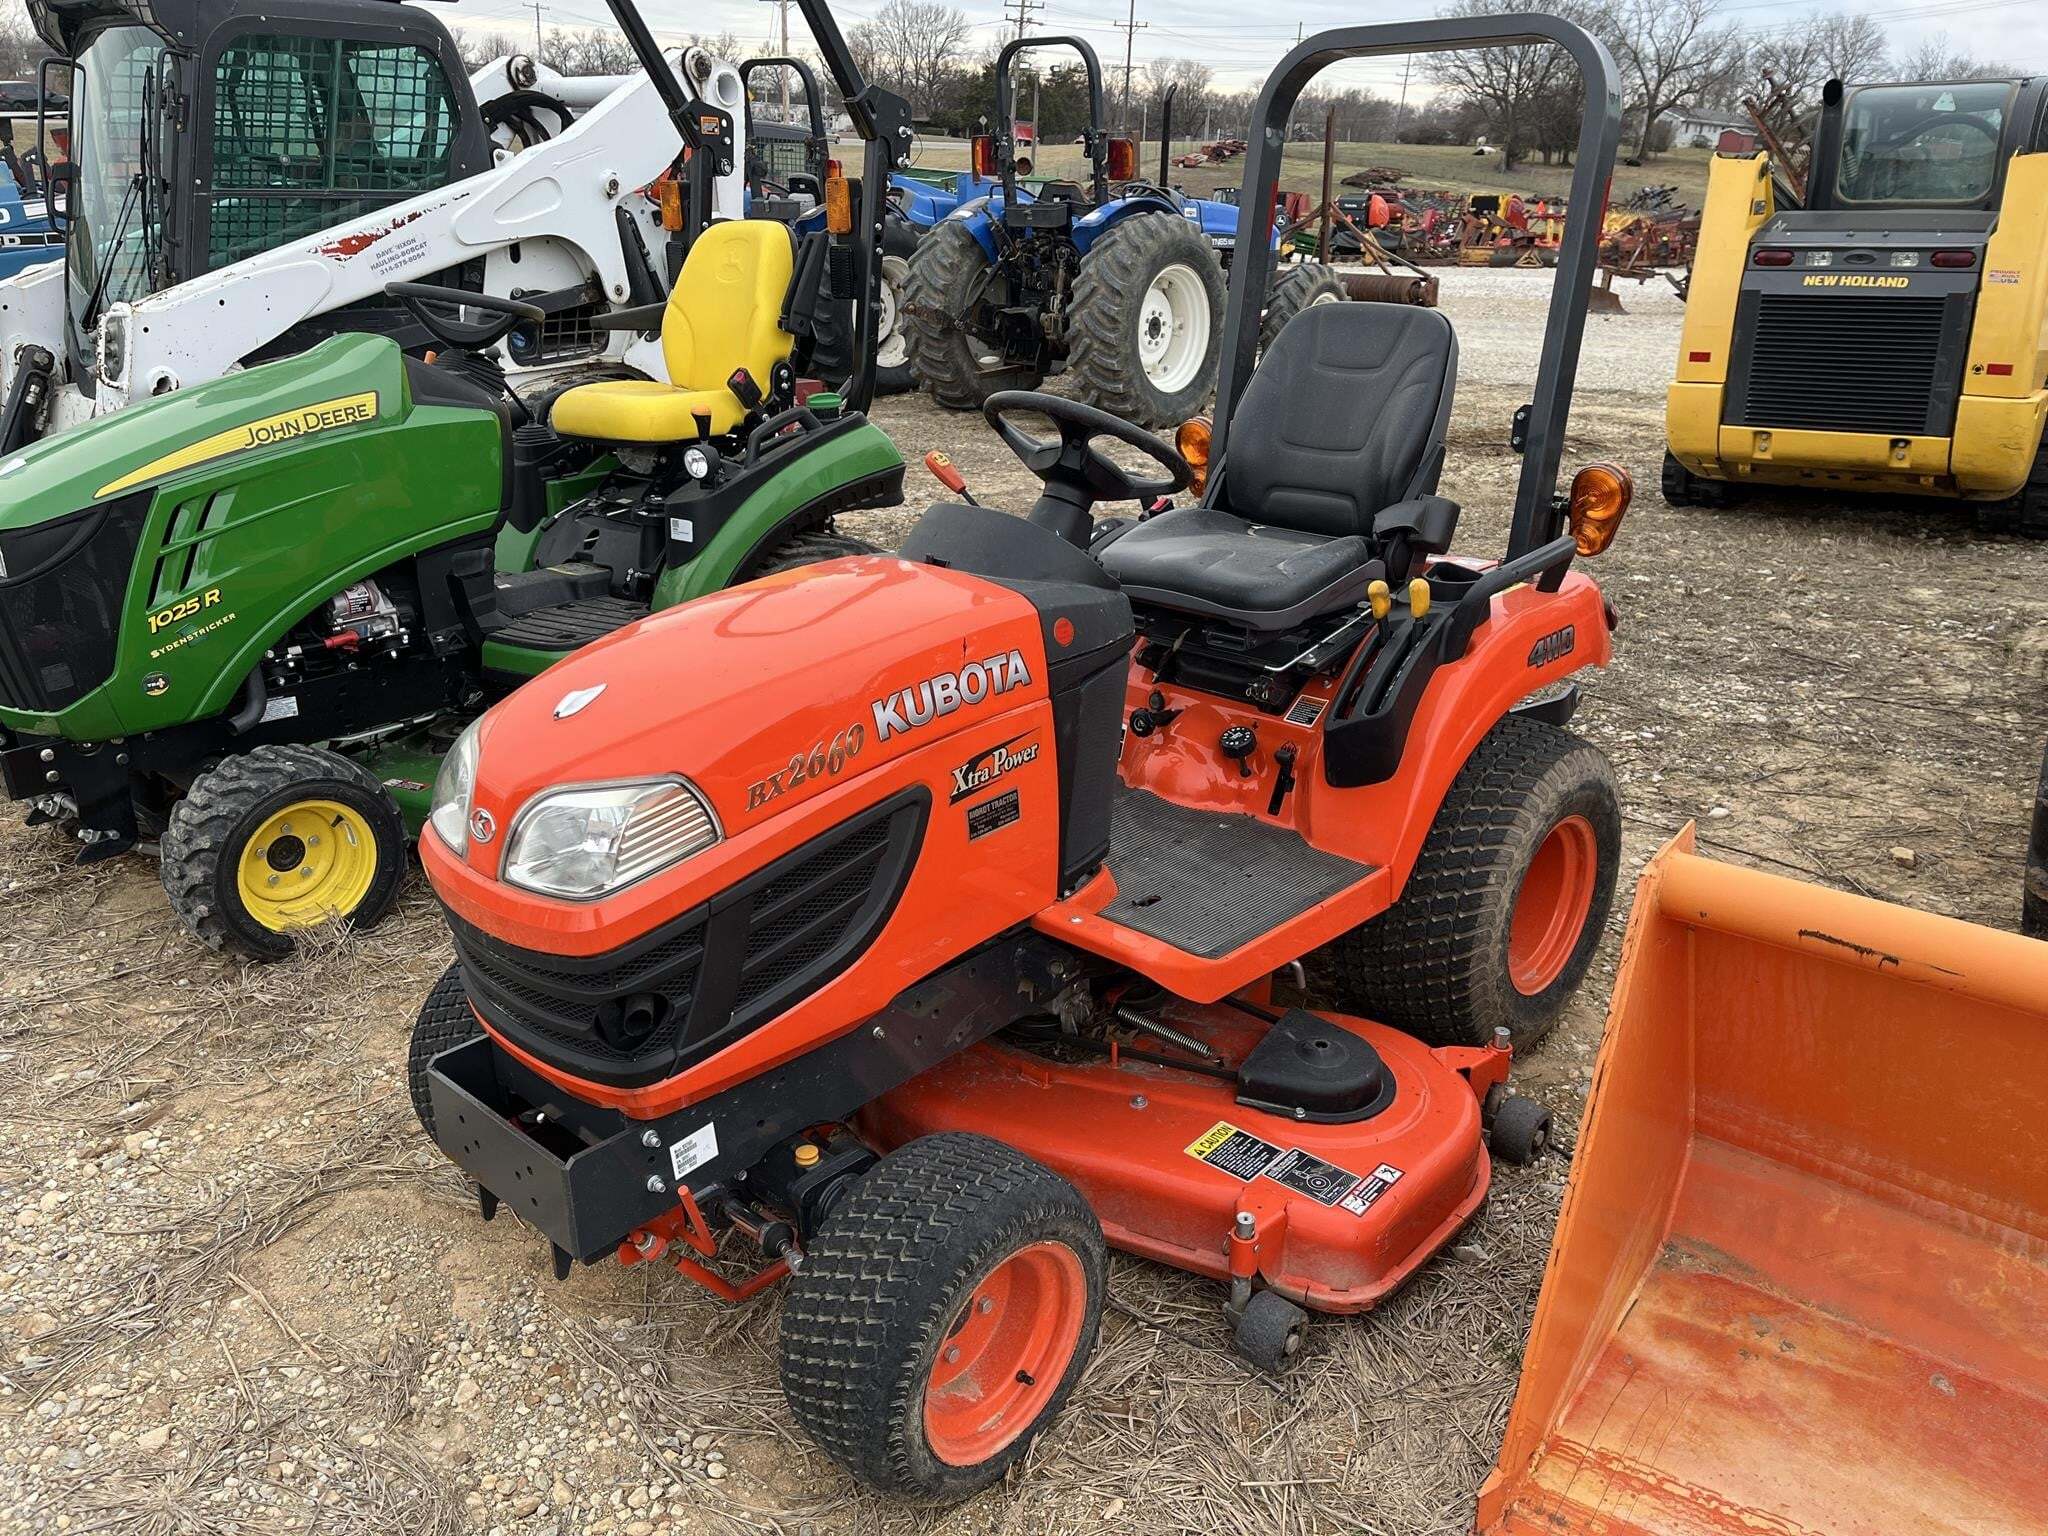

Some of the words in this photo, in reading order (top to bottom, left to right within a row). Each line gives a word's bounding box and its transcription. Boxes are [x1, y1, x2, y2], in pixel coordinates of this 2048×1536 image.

[376, 247, 394, 259] DAVE
[1803, 275, 1840, 288] NEW
[1841, 275, 1909, 288] HOLLAND
[245, 419, 301, 447] JOHN
[303, 404, 369, 430] DEERE
[148, 597, 201, 634] 1025
[204, 588, 222, 608] R
[150, 613, 236, 659] SYDENSTRICKER
[1527, 624, 1575, 669] 4WD
[872, 650, 1031, 742] KUBOTA
[744, 723, 865, 812] BX2660
[951, 764, 990, 797] Xtra
[992, 743, 1039, 777] Power
[1201, 1124, 1233, 1149] CAUTION
